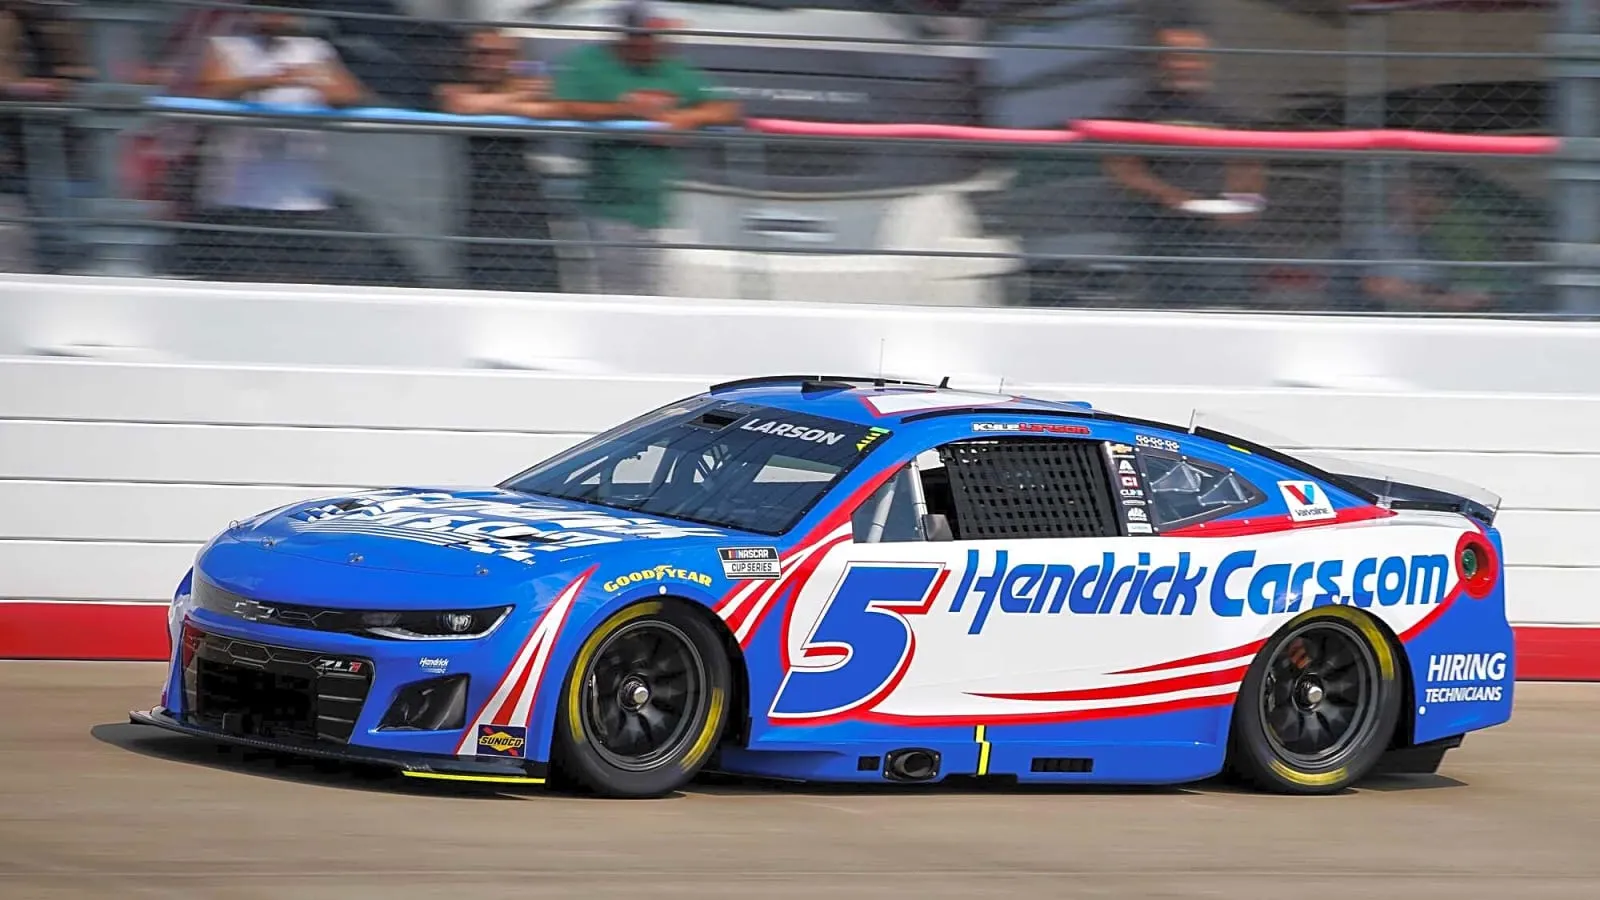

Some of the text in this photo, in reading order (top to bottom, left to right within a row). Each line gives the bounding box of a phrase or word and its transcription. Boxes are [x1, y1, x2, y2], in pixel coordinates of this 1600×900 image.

[740, 418, 846, 446] LARSON
[736, 549, 769, 560] NASCAR
[731, 562, 773, 573] CUP SERIES
[603, 565, 713, 593] GOODYEAR
[767, 560, 949, 721] 5
[419, 657, 450, 668] Hendrick
[1427, 652, 1507, 682] HIRING
[1425, 686, 1503, 703] TECHNICIANS
[480, 736, 523, 748] SUNOCO
